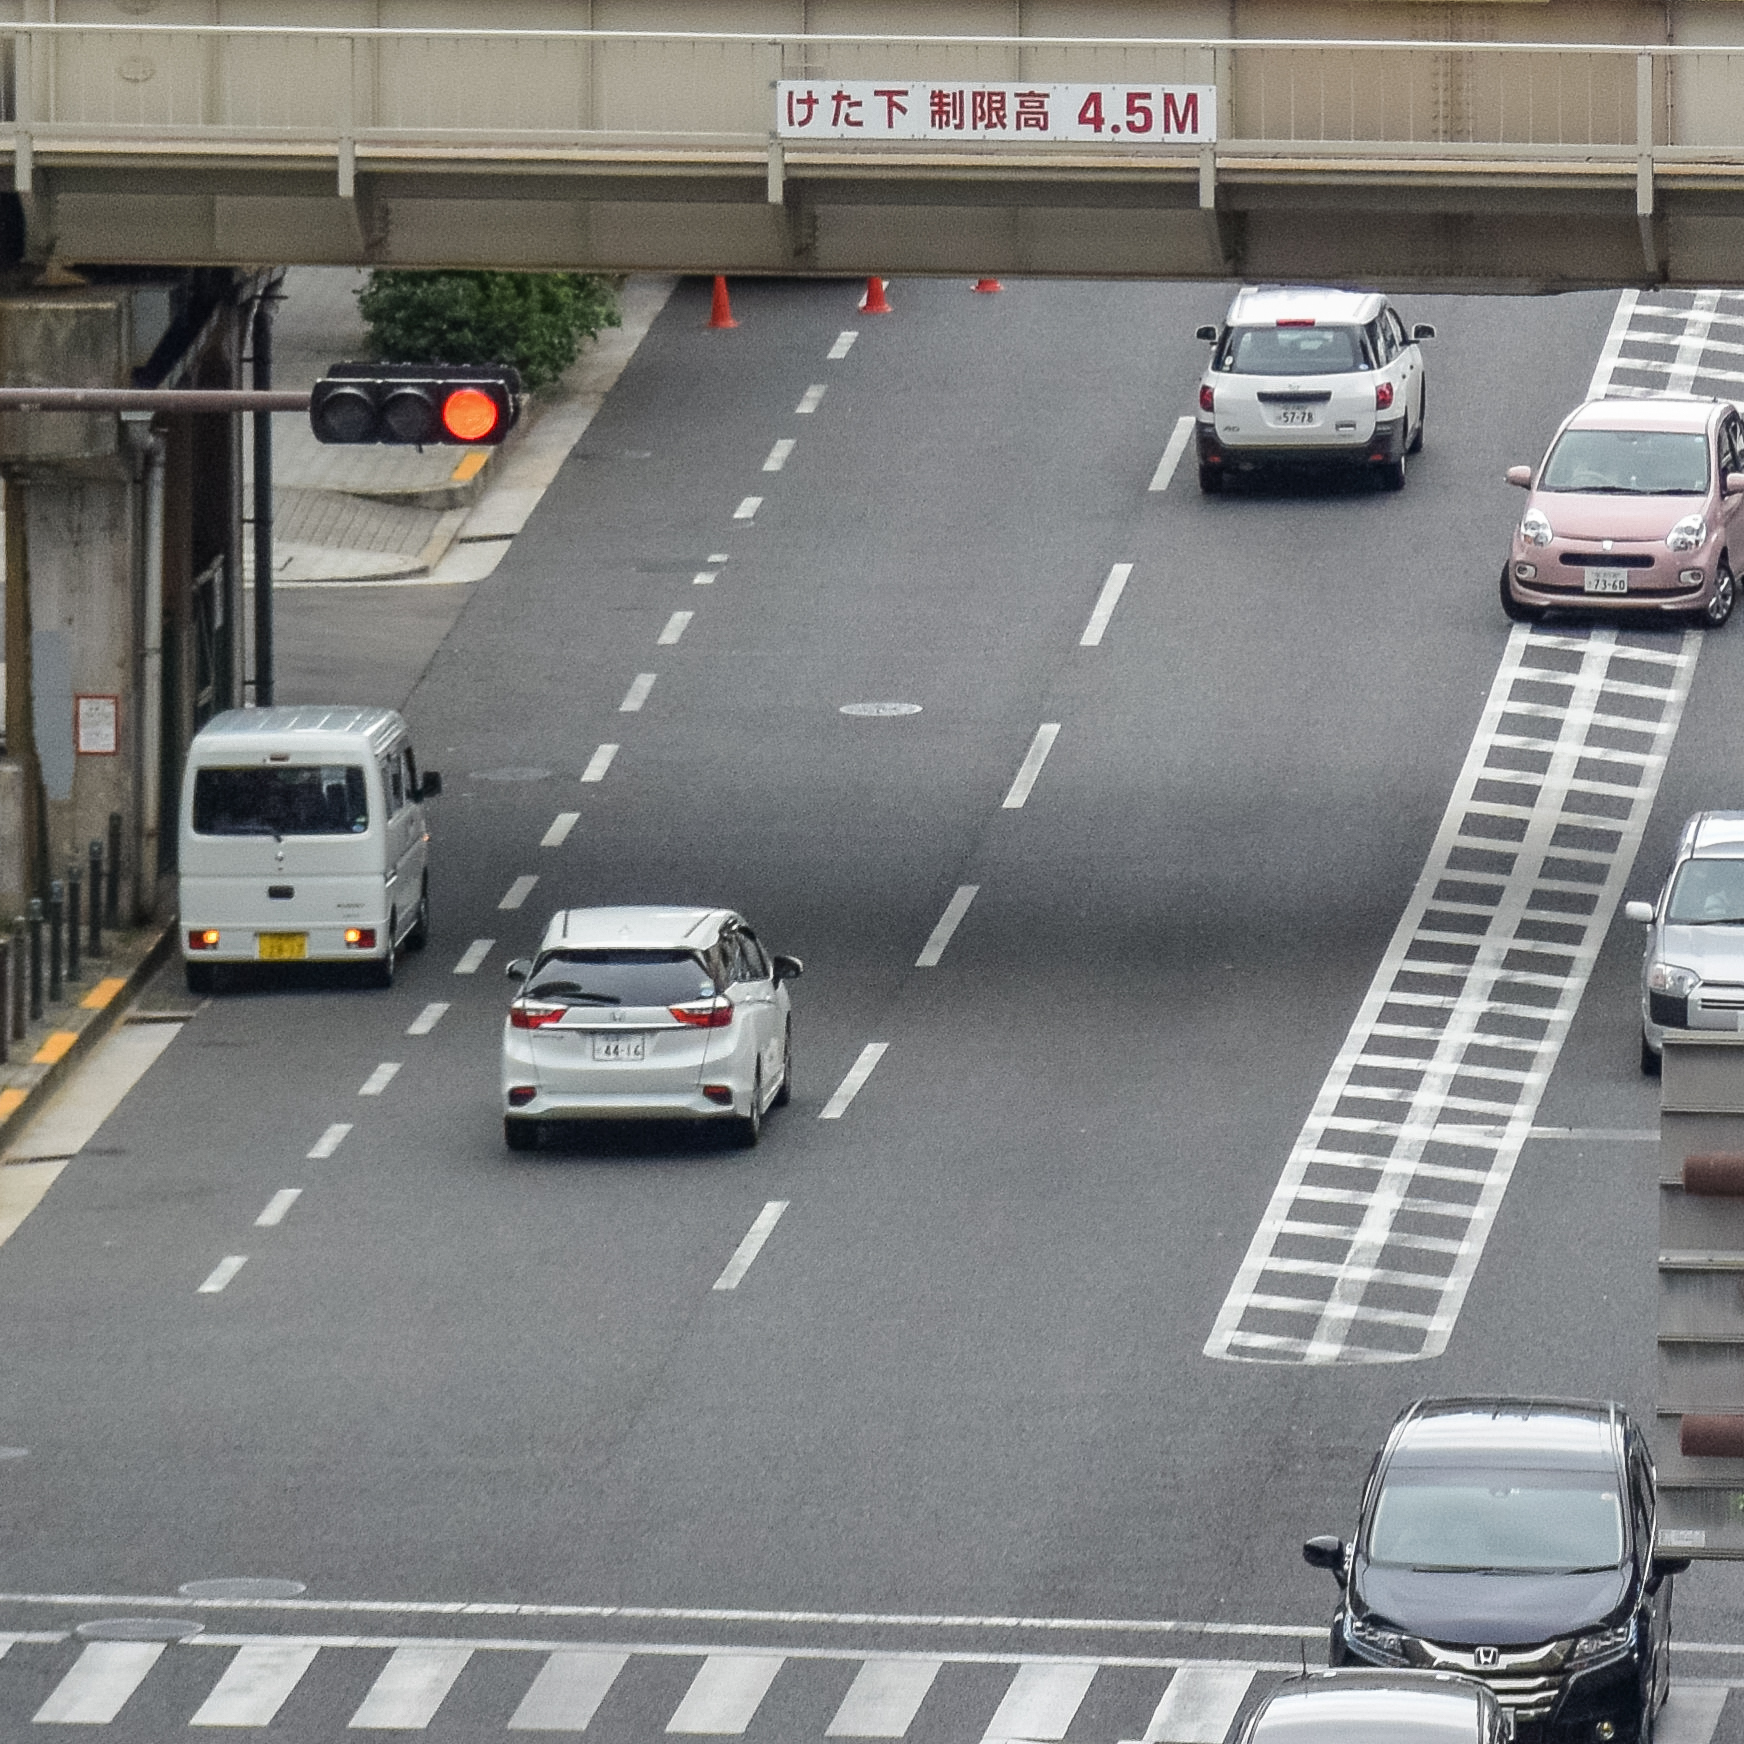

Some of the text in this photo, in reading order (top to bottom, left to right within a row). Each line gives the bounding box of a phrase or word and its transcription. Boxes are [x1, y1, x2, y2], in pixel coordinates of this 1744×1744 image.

[786, 89, 1200, 135] けた下 制限高 4.5M
[1594, 579, 1625, 591] 73-60
